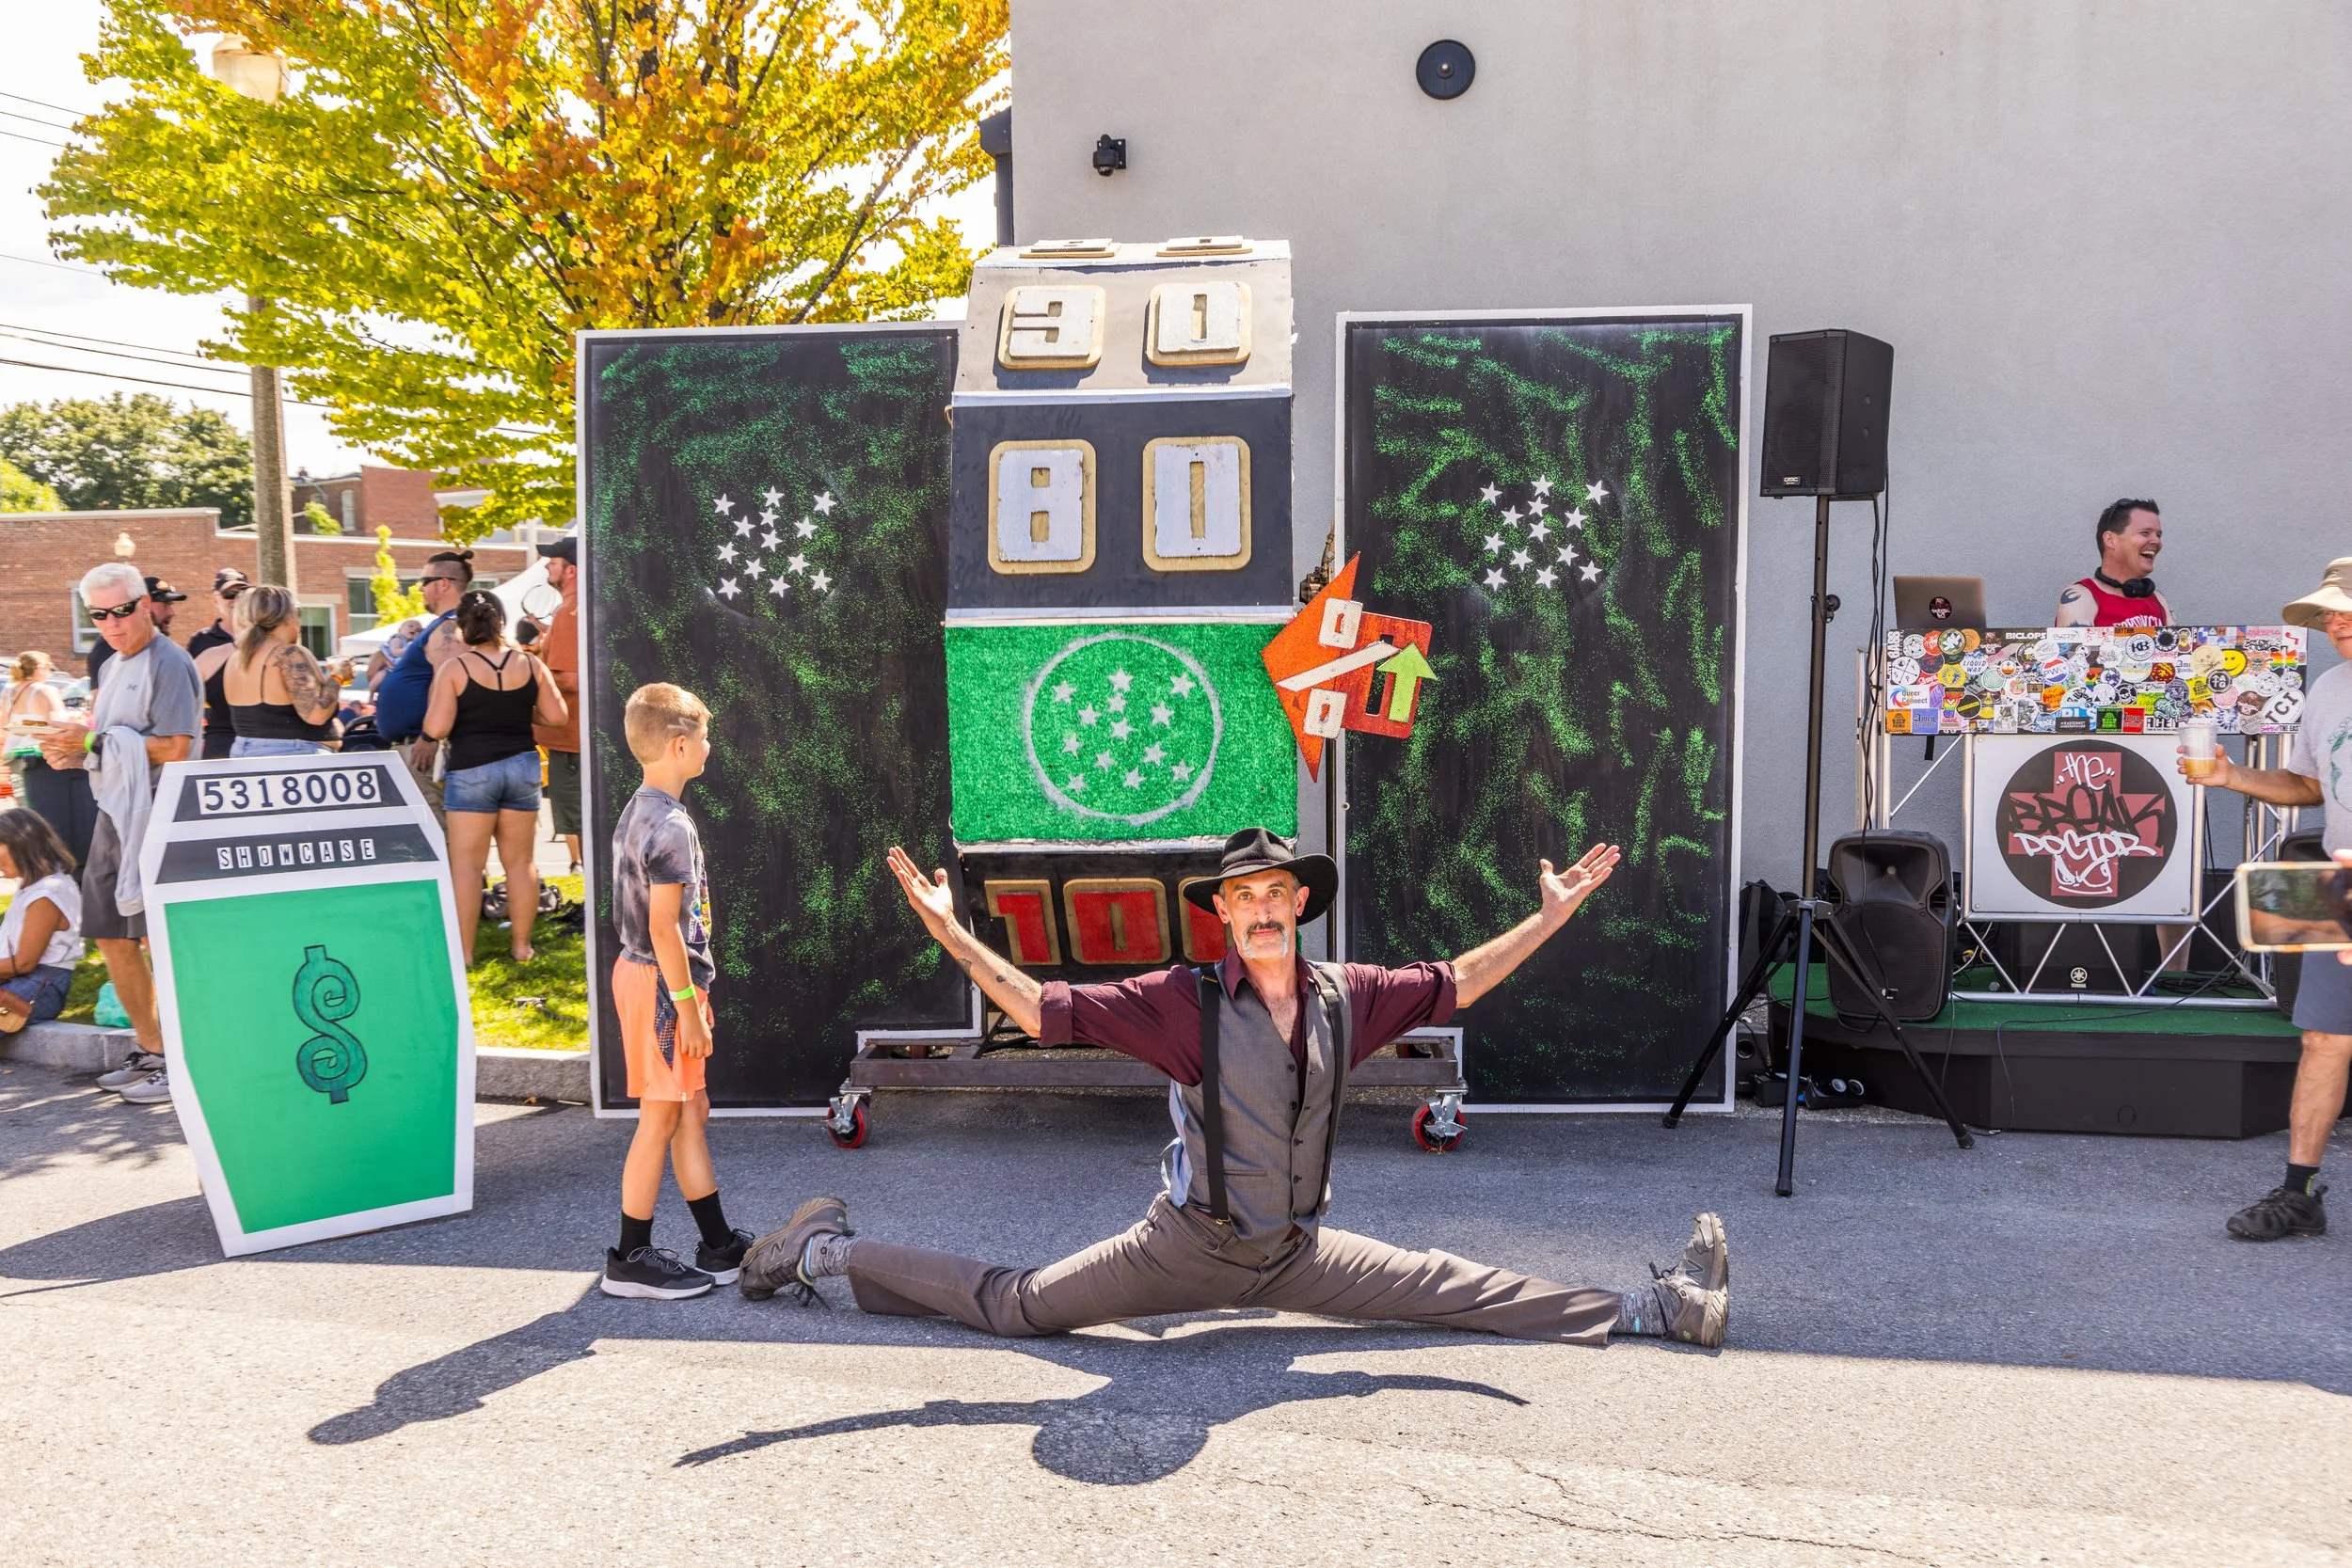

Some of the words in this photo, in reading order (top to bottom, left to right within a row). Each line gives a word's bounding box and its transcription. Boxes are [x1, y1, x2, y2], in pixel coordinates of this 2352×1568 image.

[997, 443, 1242, 562] 80
[2265, 692, 2298, 723] TCI
[203, 770, 376, 811] 5318008
[217, 838, 375, 870] SHOWCASE
[2013, 829, 2157, 861] DOCTOR
